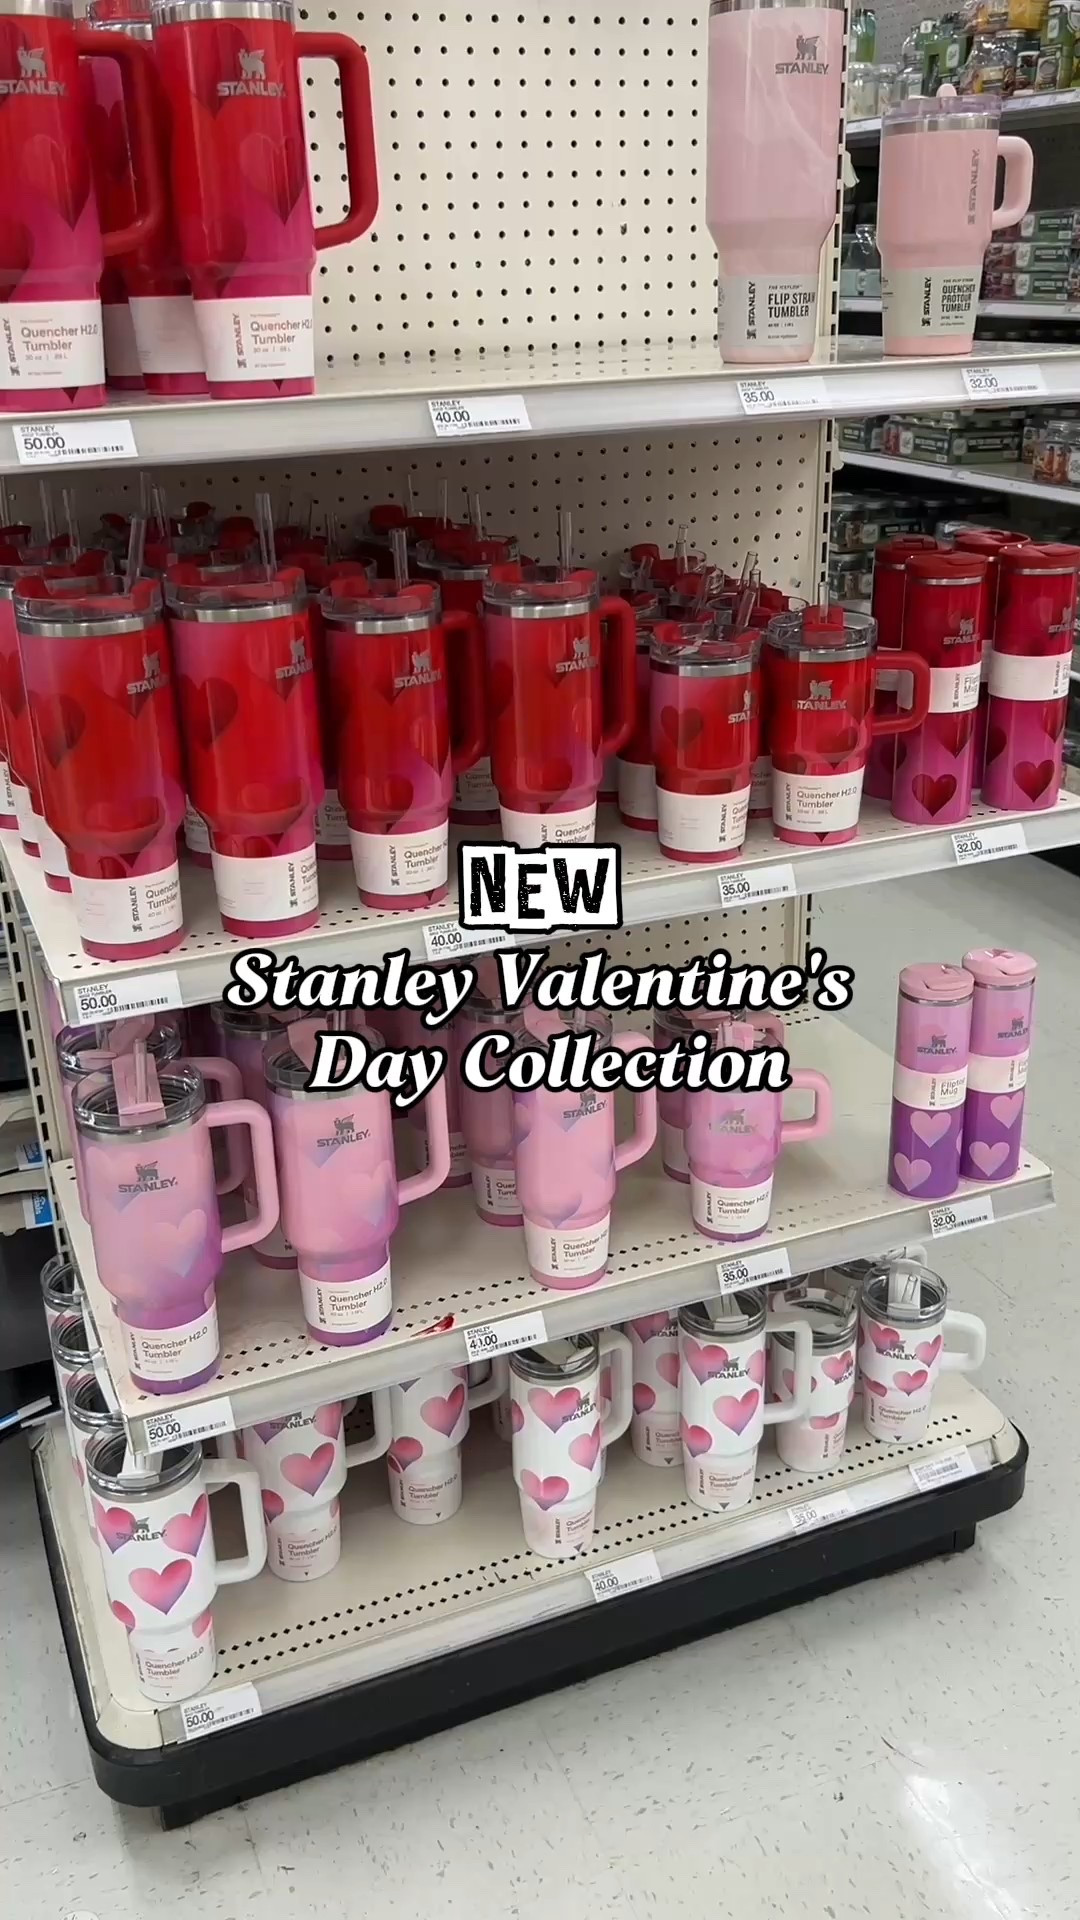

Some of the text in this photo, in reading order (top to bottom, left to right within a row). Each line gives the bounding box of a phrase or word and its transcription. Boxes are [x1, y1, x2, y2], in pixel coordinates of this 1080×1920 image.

[775, 62, 829, 75] STANLEY
[217, 81, 285, 96] STANLEY
[968, 149, 979, 213] STANLEY
[768, 293, 790, 305] FLIP
[924, 277, 932, 316] STANLEY
[748, 281, 756, 326] STANLEY
[941, 302, 971, 312] TUMBLER
[768, 305, 809, 318] TUMBLER
[21, 326, 78, 338] Quencher
[250, 320, 300, 332] Quencher
[3, 318, 16, 362] STANLEY
[232, 312, 245, 356] STANLEY
[251, 333, 296, 345] Tumbler
[22, 340, 72, 352] Tumbler
[969, 377, 998, 389] 32.00
[743, 390, 775, 403] 35.00
[431, 400, 461, 408] STANLEY
[435, 410, 470, 423] 40.00
[20, 425, 55, 433] STANLEY
[24, 436, 65, 450] 50.00
[797, 786, 857, 799] Quencher H2.0
[797, 800, 833, 808] Tumbler
[555, 824, 591, 837] Quencher
[404, 844, 442, 859] Quencher
[957, 840, 983, 853] 32.00
[389, 845, 398, 877] STANLEY
[405, 856, 438, 868] Tumbler
[288, 862, 296, 897] STANLEY
[720, 873, 744, 881] STANLEY
[722, 881, 750, 896] 35.00
[129, 885, 139, 922] STANLEY
[146, 892, 178, 910] Tumbler
[428, 923, 455, 932] STANLEY
[431, 932, 462, 947] 40.00
[77, 984, 109, 995] STANLEY
[80, 994, 118, 1011] 50.00
[917, 1046, 957, 1055] STANLEY
[940, 1087, 958, 1096] Mug
[563, 1100, 607, 1119] STANLEY
[317, 1129, 370, 1147] STANLEY
[118, 1177, 177, 1193] STANLEY
[717, 1199, 755, 1207] Quencher
[933, 1213, 956, 1228] 32.00
[563, 1237, 600, 1250] Quencher
[564, 1247, 595, 1258] Tumbler
[723, 1267, 748, 1282] 35.00
[329, 1289, 372, 1302] Quencher
[330, 1301, 367, 1311] Tumbler
[467, 1326, 490, 1336] STANLEY
[141, 1326, 208, 1350] Quencher H2.0
[142, 1349, 182, 1358] Tumbler
[708, 1368, 750, 1379] STANLEY
[146, 1413, 173, 1425] STANLEY
[270, 1415, 316, 1429] STANLEY
[149, 1422, 181, 1440] 50.00
[115, 1529, 167, 1541] STANLEY
[288, 1538, 324, 1550] Quencher
[288, 1547, 320, 1557] Tumbler
[595, 1576, 619, 1592] 40.00
[145, 1646, 204, 1669] Quencher H2.0
[146, 1667, 180, 1676] Tumbler
[186, 1710, 215, 1728] 50.00
